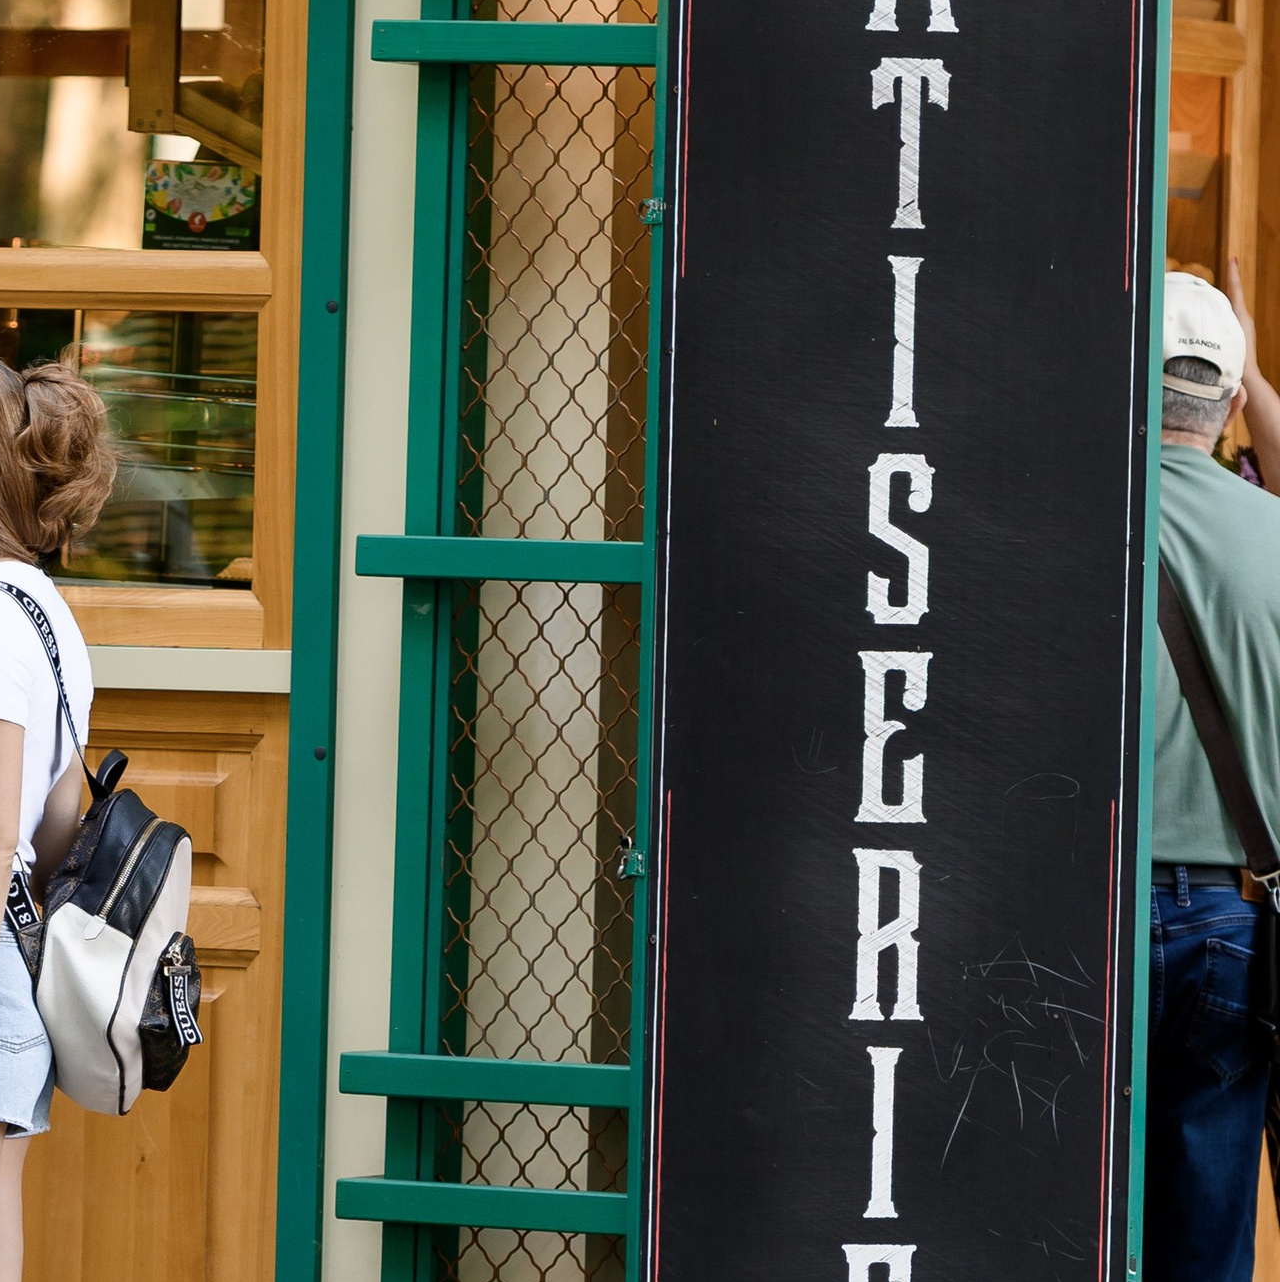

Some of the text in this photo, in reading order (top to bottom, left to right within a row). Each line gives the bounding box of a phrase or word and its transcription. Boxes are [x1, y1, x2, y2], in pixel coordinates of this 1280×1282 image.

[1189, 338, 1222, 351] SANDER
[22, 596, 59, 659] GUESS
[174, 975, 197, 1044] GUESS
